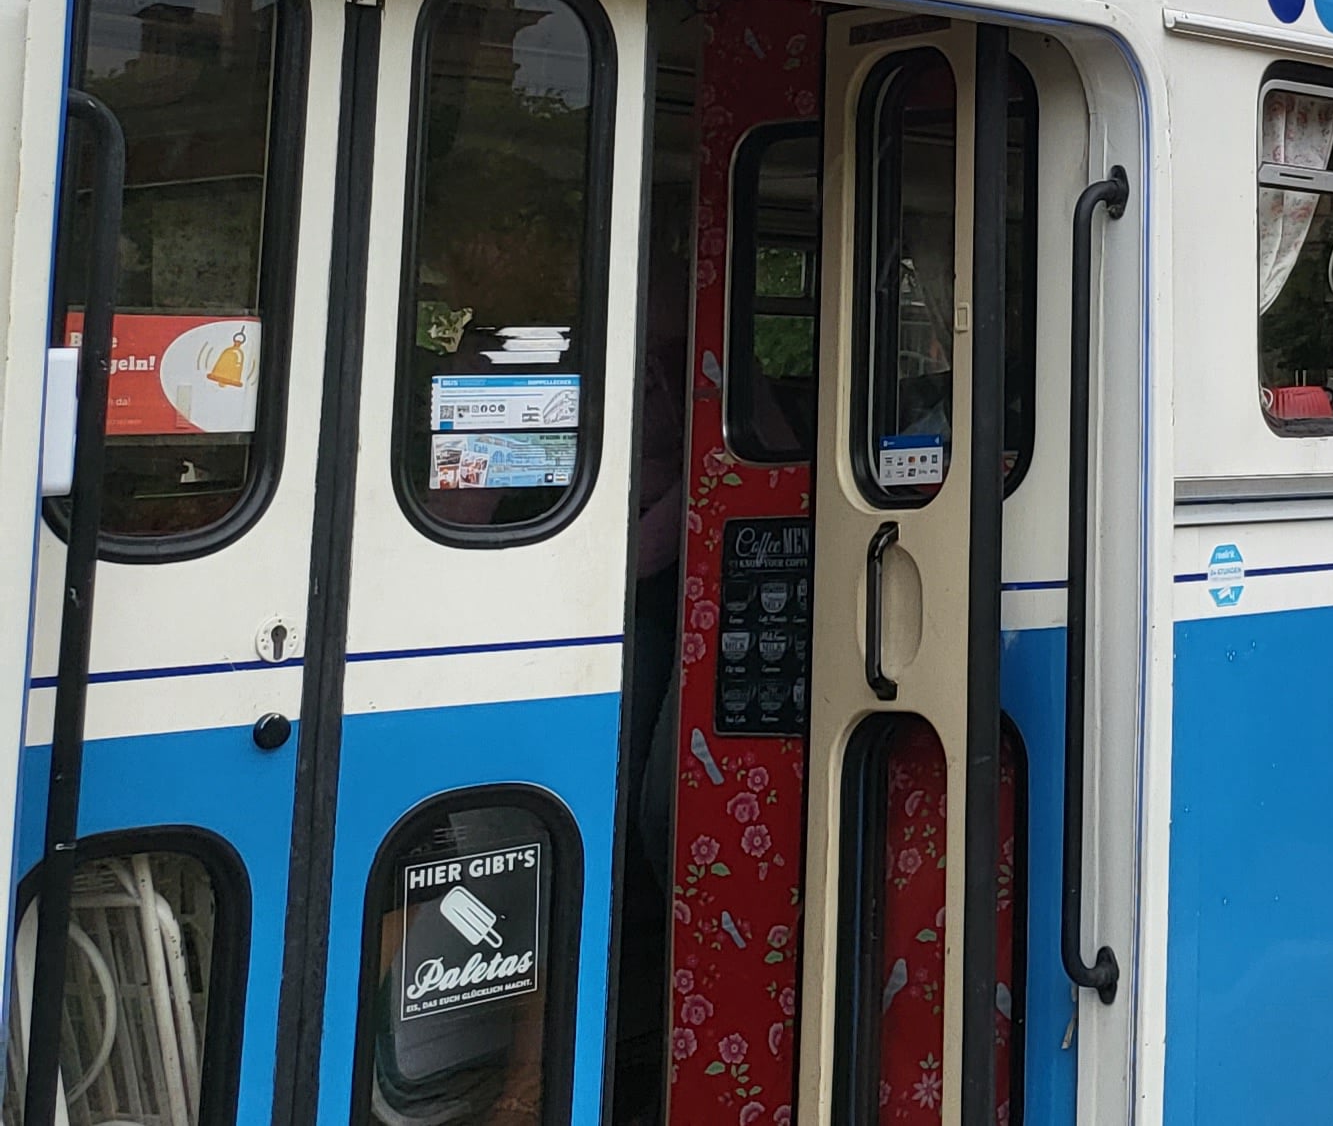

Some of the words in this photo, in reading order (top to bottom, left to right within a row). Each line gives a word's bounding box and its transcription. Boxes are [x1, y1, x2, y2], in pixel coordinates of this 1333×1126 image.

[783, 527, 809, 554] MEN
[409, 862, 463, 890] HIER
[406, 950, 534, 1000] Paletas
[406, 1005, 422, 1014] EIS,
[422, 999, 438, 1009] DAS
[439, 994, 460, 1006] EUCH
[461, 984, 504, 1000] GLÜCKLICH
[504, 977, 533, 991] MACHT.
